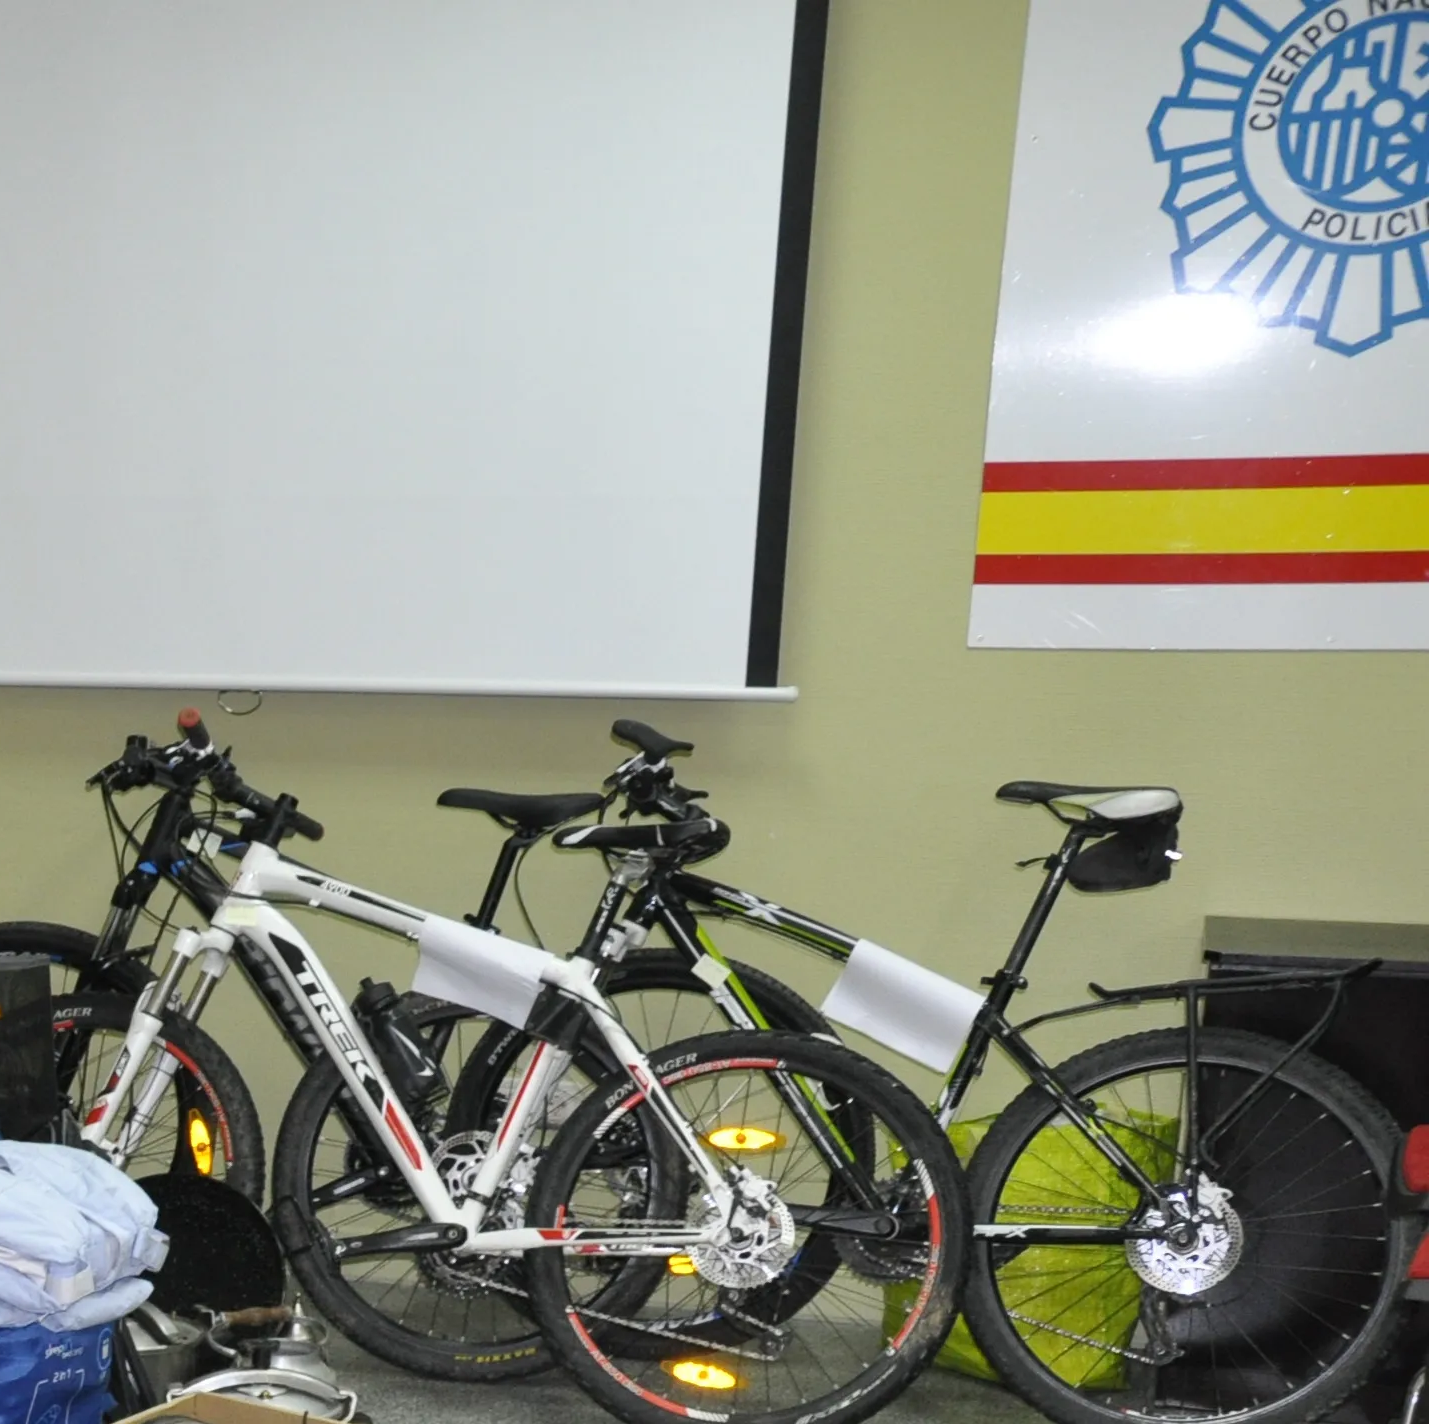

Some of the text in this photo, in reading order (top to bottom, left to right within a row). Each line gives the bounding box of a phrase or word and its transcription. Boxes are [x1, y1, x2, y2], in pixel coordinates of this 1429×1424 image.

[1248, 7, 1349, 132] CUERPO
[1301, 202, 1429, 242] POLICI
[53, 1007, 93, 1019] AGER
[295, 959, 378, 1084] TREK
